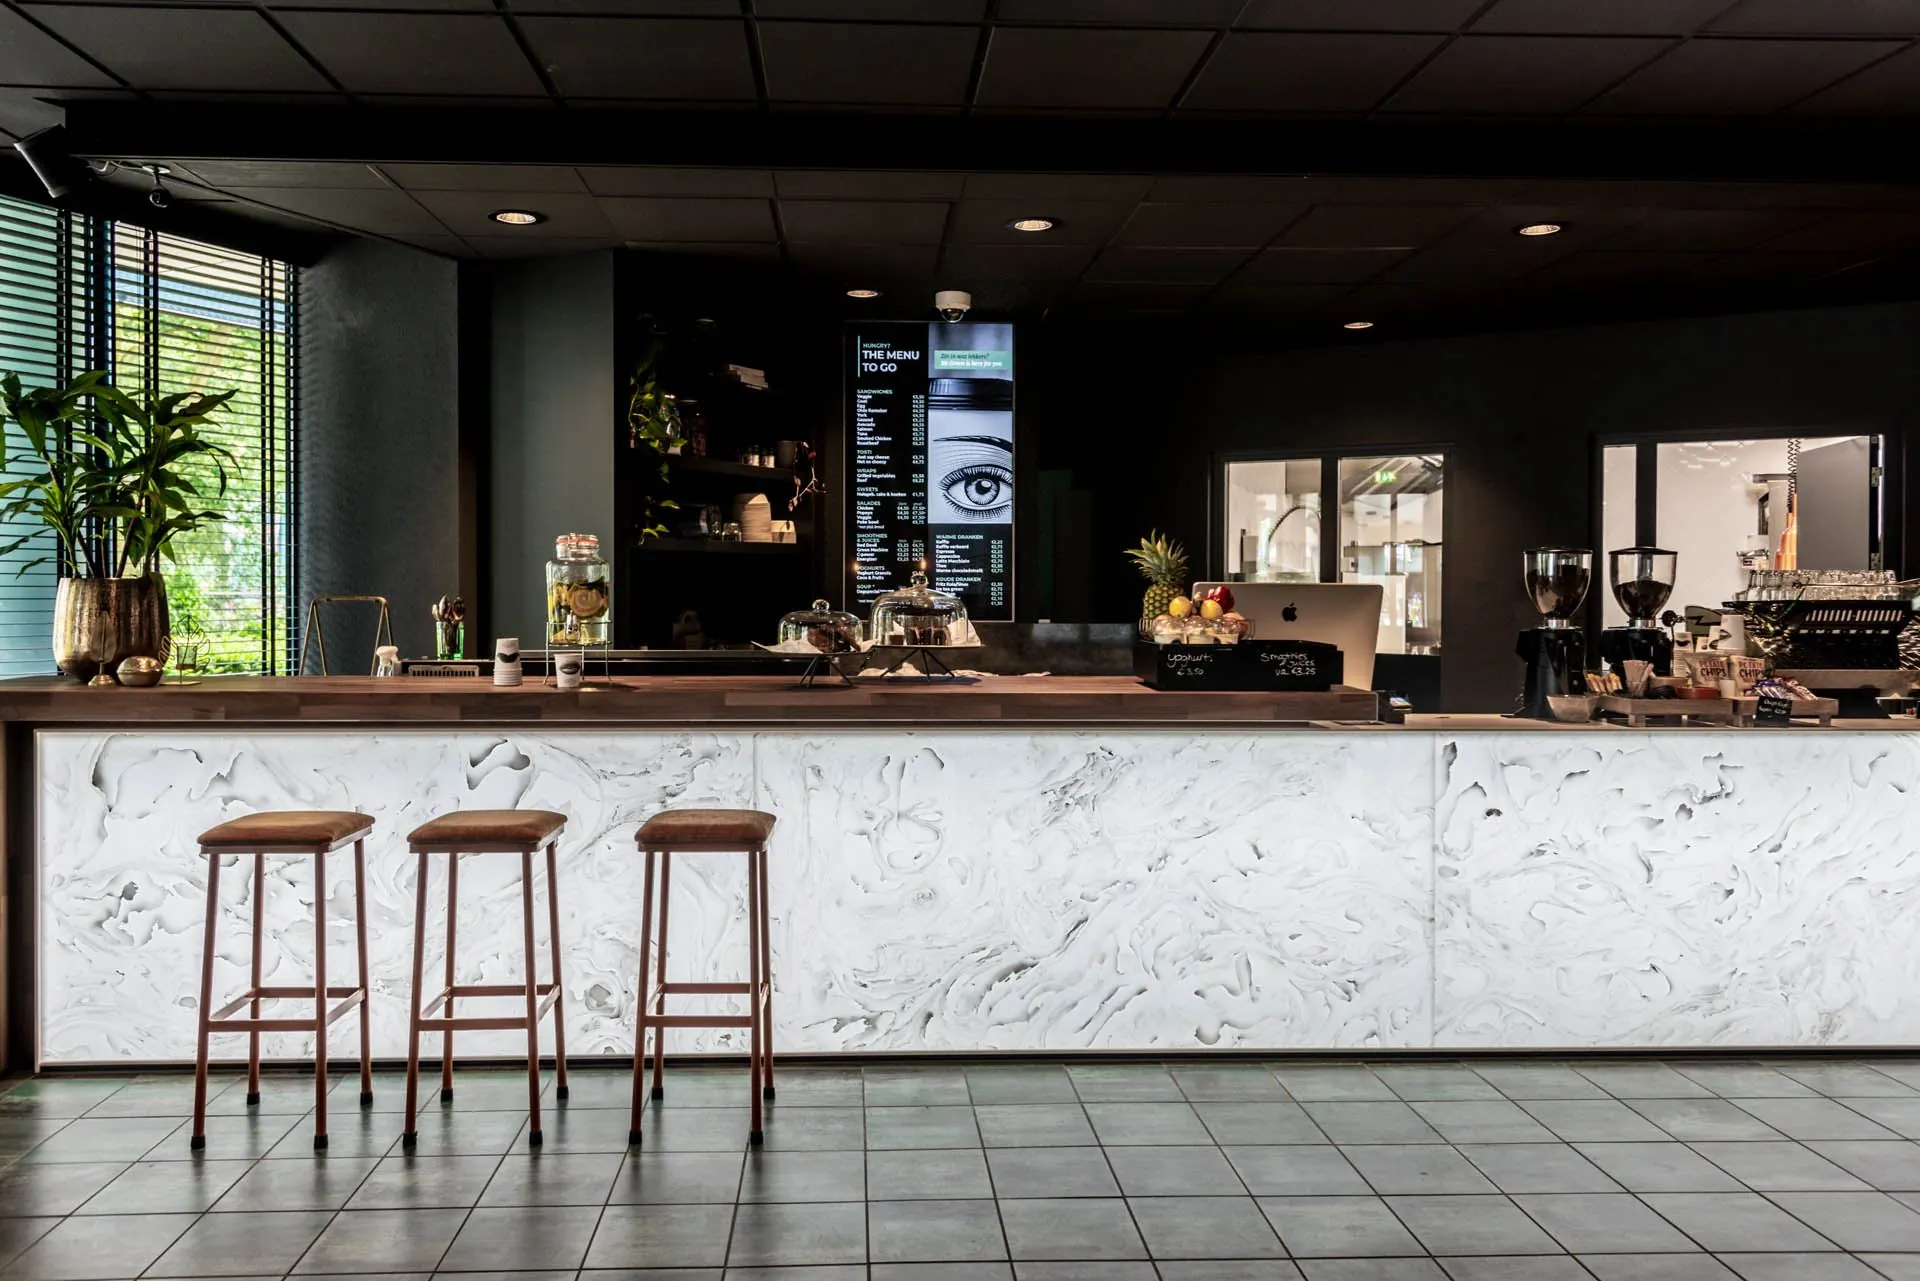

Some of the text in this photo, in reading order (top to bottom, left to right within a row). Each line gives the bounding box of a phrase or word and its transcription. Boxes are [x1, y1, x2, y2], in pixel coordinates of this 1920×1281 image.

[862, 350, 920, 360] THE MENU
[862, 363, 897, 372] TO GO
[1260, 652, 1308, 662] Smoothies
[1700, 668, 1727, 677] CHIPS
